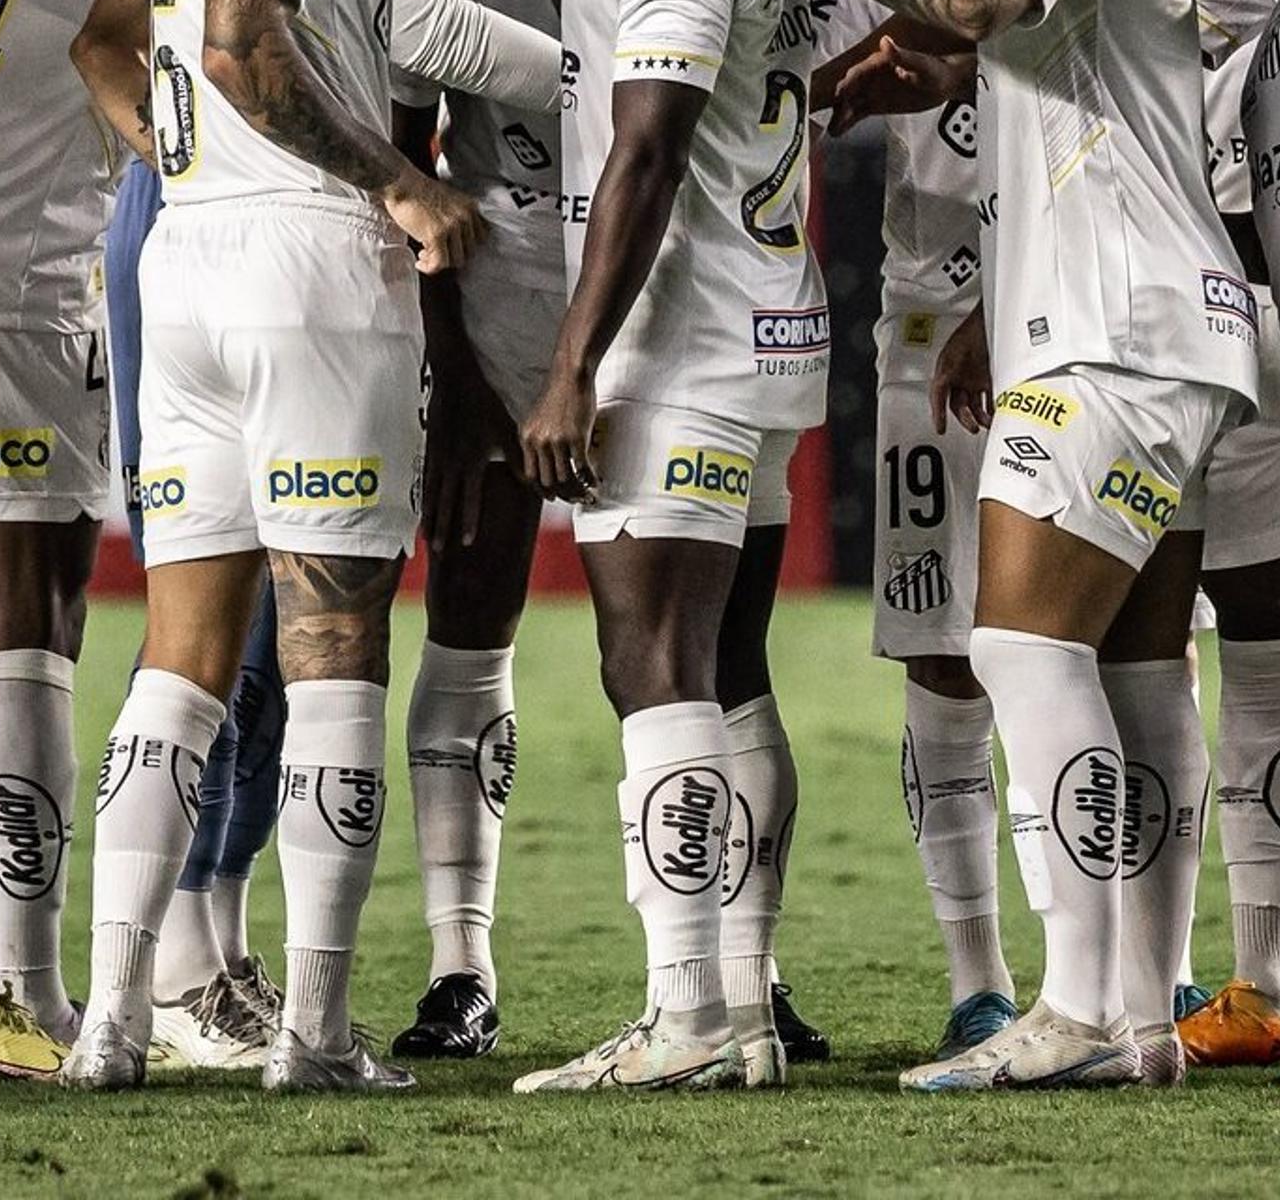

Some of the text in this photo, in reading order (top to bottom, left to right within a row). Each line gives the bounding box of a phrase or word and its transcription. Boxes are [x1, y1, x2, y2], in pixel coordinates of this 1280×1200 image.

[740, 69, 807, 248] 2
[269, 461, 379, 503] placo
[664, 451, 750, 497] placo
[884, 443, 946, 529] 19
[999, 456, 1038, 478] umbro
[1097, 470, 1178, 528] placo
[338, 767, 376, 832] Kodi
[663, 776, 718, 879] Kodilar
[1075, 755, 1118, 863] Kodilar
